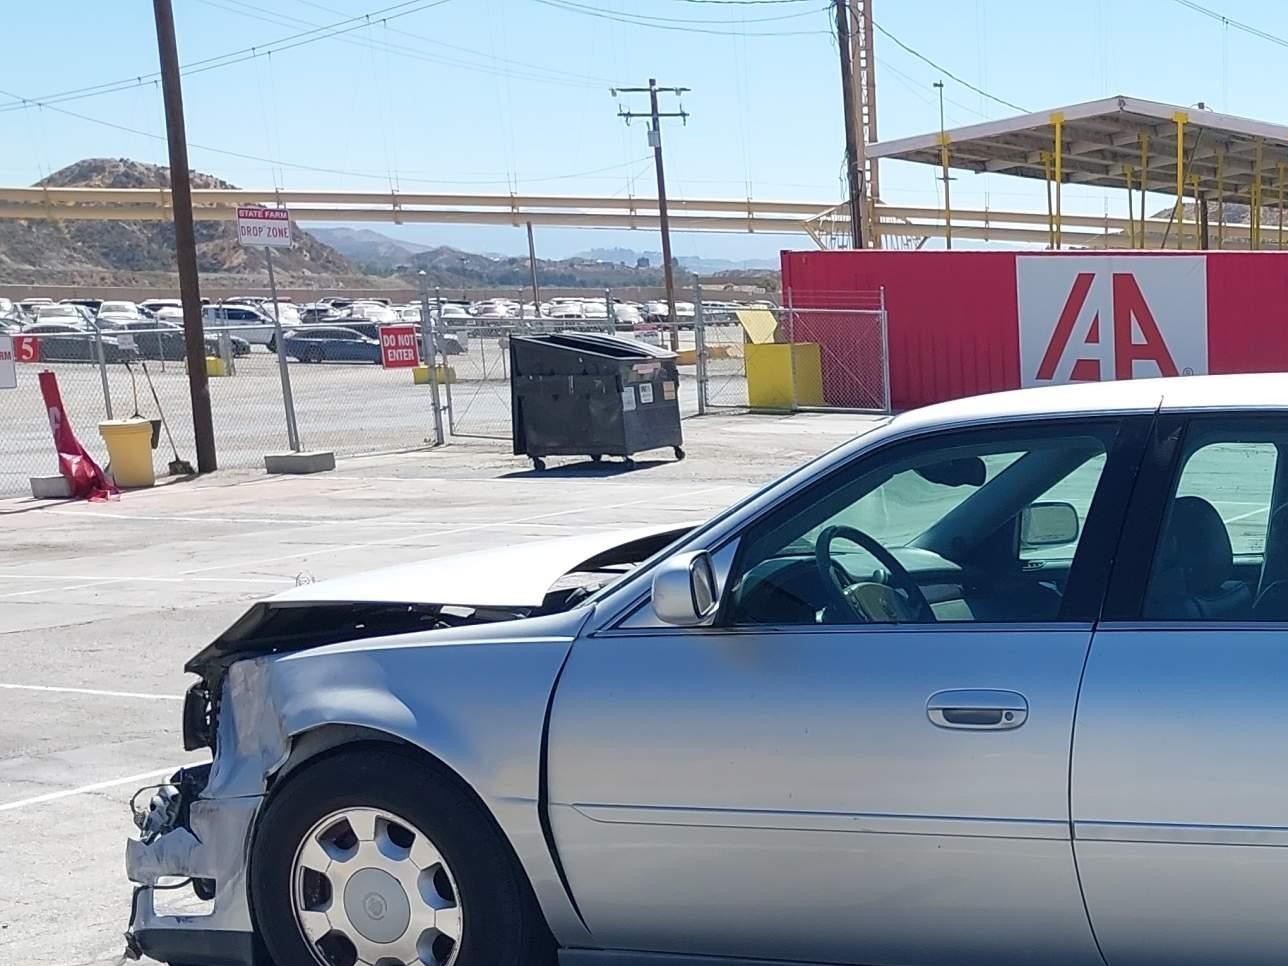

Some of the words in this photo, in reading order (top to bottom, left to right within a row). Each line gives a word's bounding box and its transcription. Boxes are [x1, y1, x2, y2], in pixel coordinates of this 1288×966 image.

[239, 210, 264, 218] STATE
[264, 210, 288, 219] FARM
[240, 225, 264, 237] DROP
[266, 226, 289, 239] ZONE
[382, 334, 397, 347] DO
[397, 334, 414, 347] NOT
[21, 337, 34, 360] 5
[387, 349, 415, 361] ENTER
